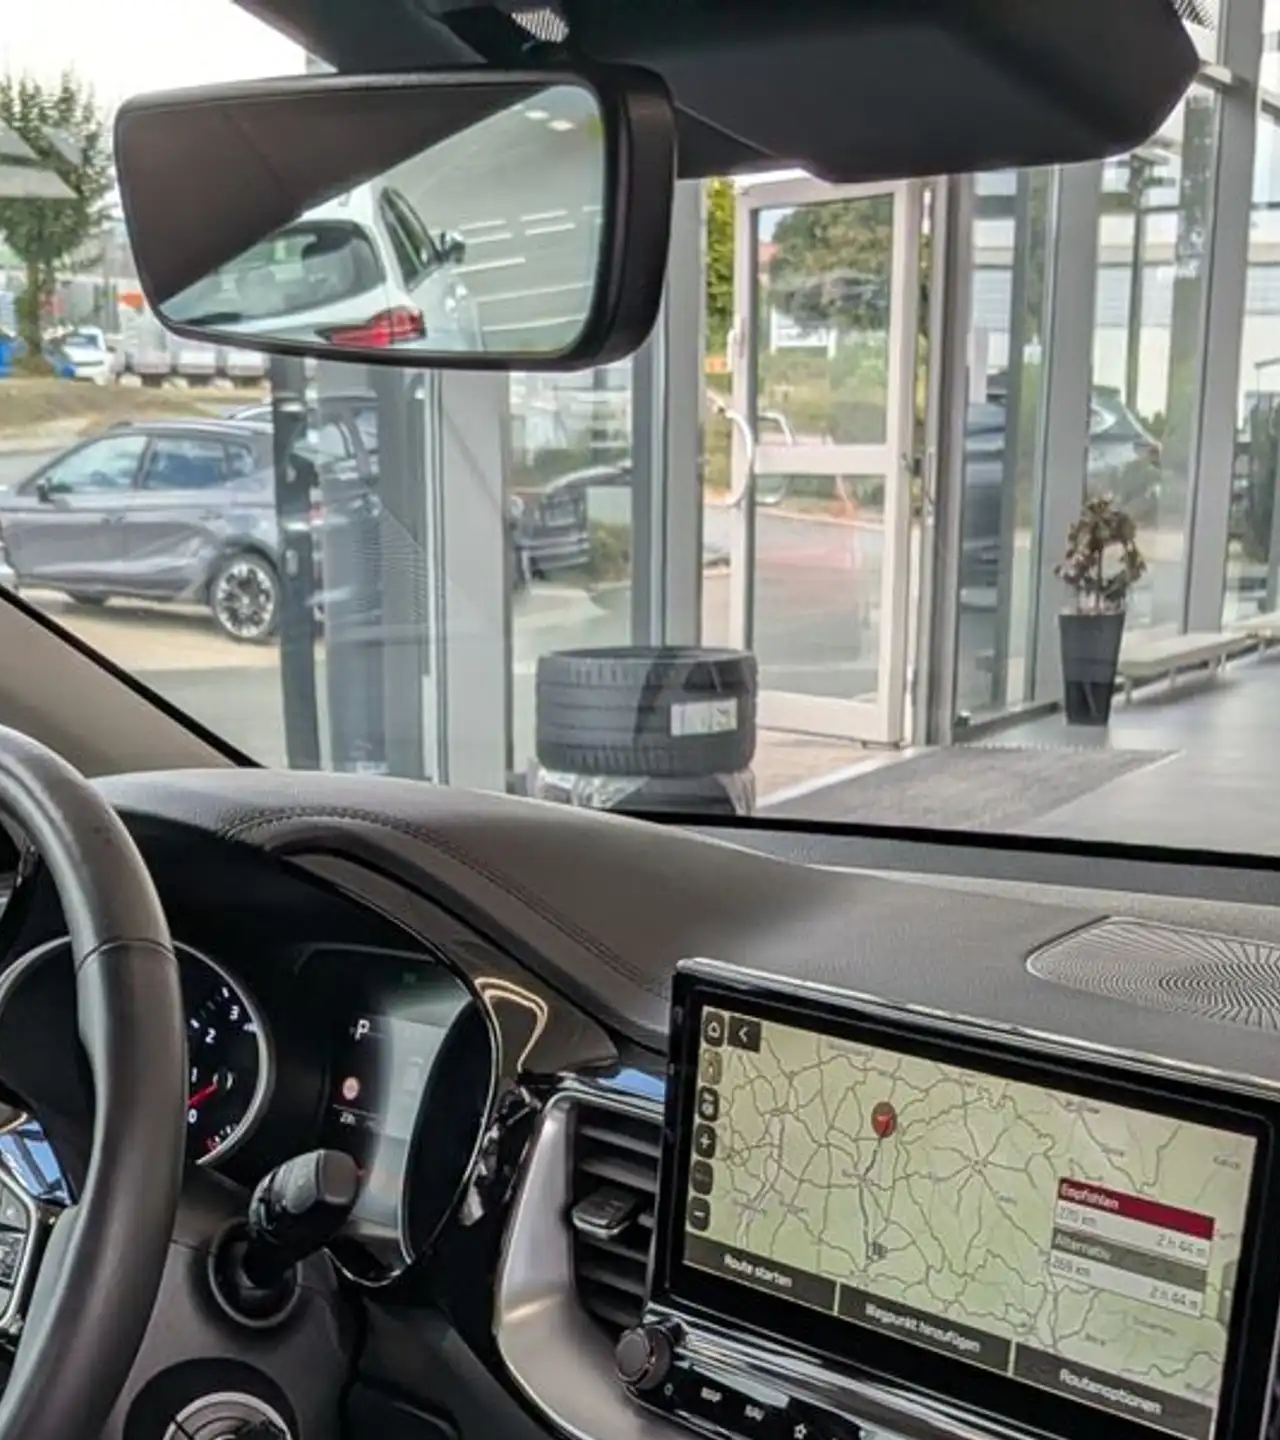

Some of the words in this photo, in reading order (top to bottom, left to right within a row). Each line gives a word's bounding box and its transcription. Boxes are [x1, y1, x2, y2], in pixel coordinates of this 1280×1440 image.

[229, 1004, 240, 1021] 3
[205, 1027, 217, 1044] 2
[354, 1018, 371, 1042] P
[723, 1252, 753, 1276] Route
